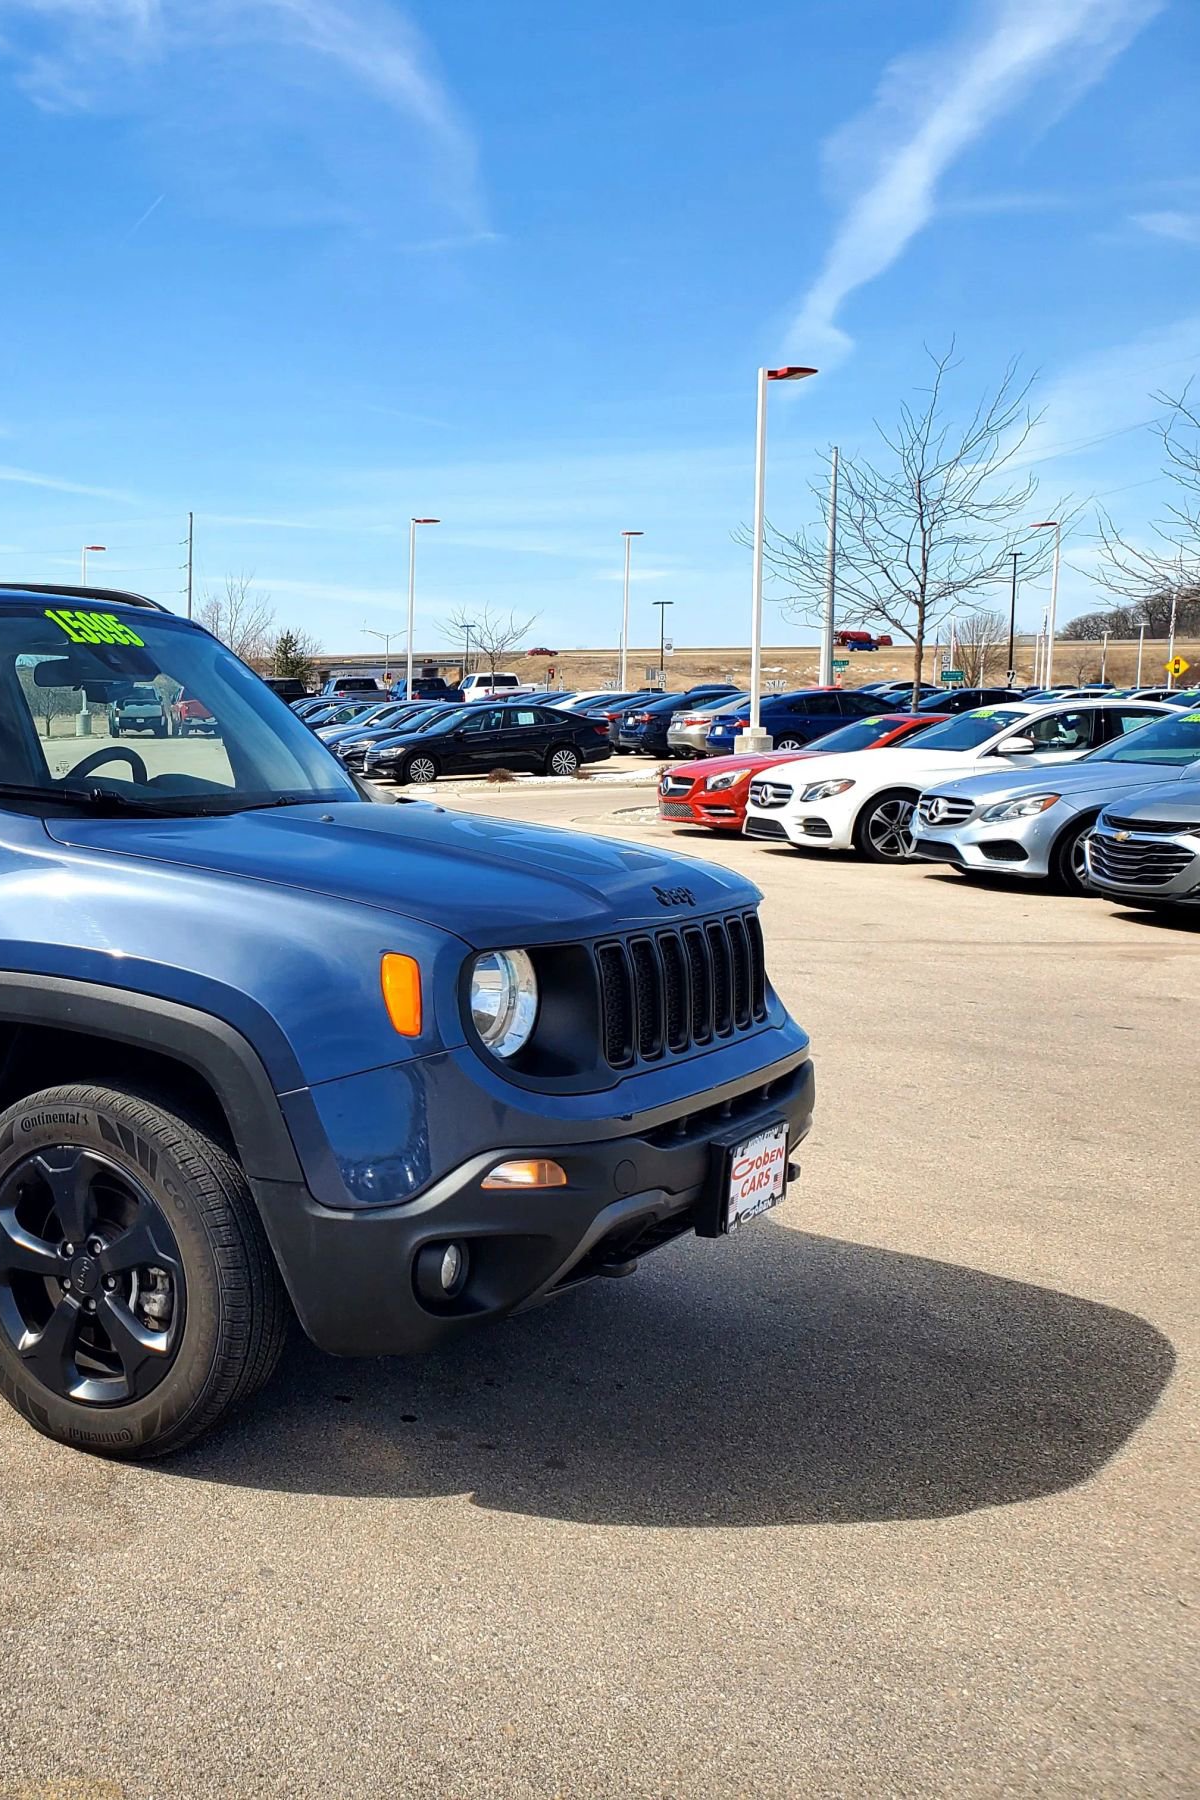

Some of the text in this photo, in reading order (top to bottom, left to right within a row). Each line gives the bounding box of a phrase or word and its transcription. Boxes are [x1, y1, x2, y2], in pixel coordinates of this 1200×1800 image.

[44, 609, 145, 647] 15995
[651, 885, 696, 907] Jeep
[21, 1111, 80, 1132] Continental
[740, 1167, 771, 1198] CARS
